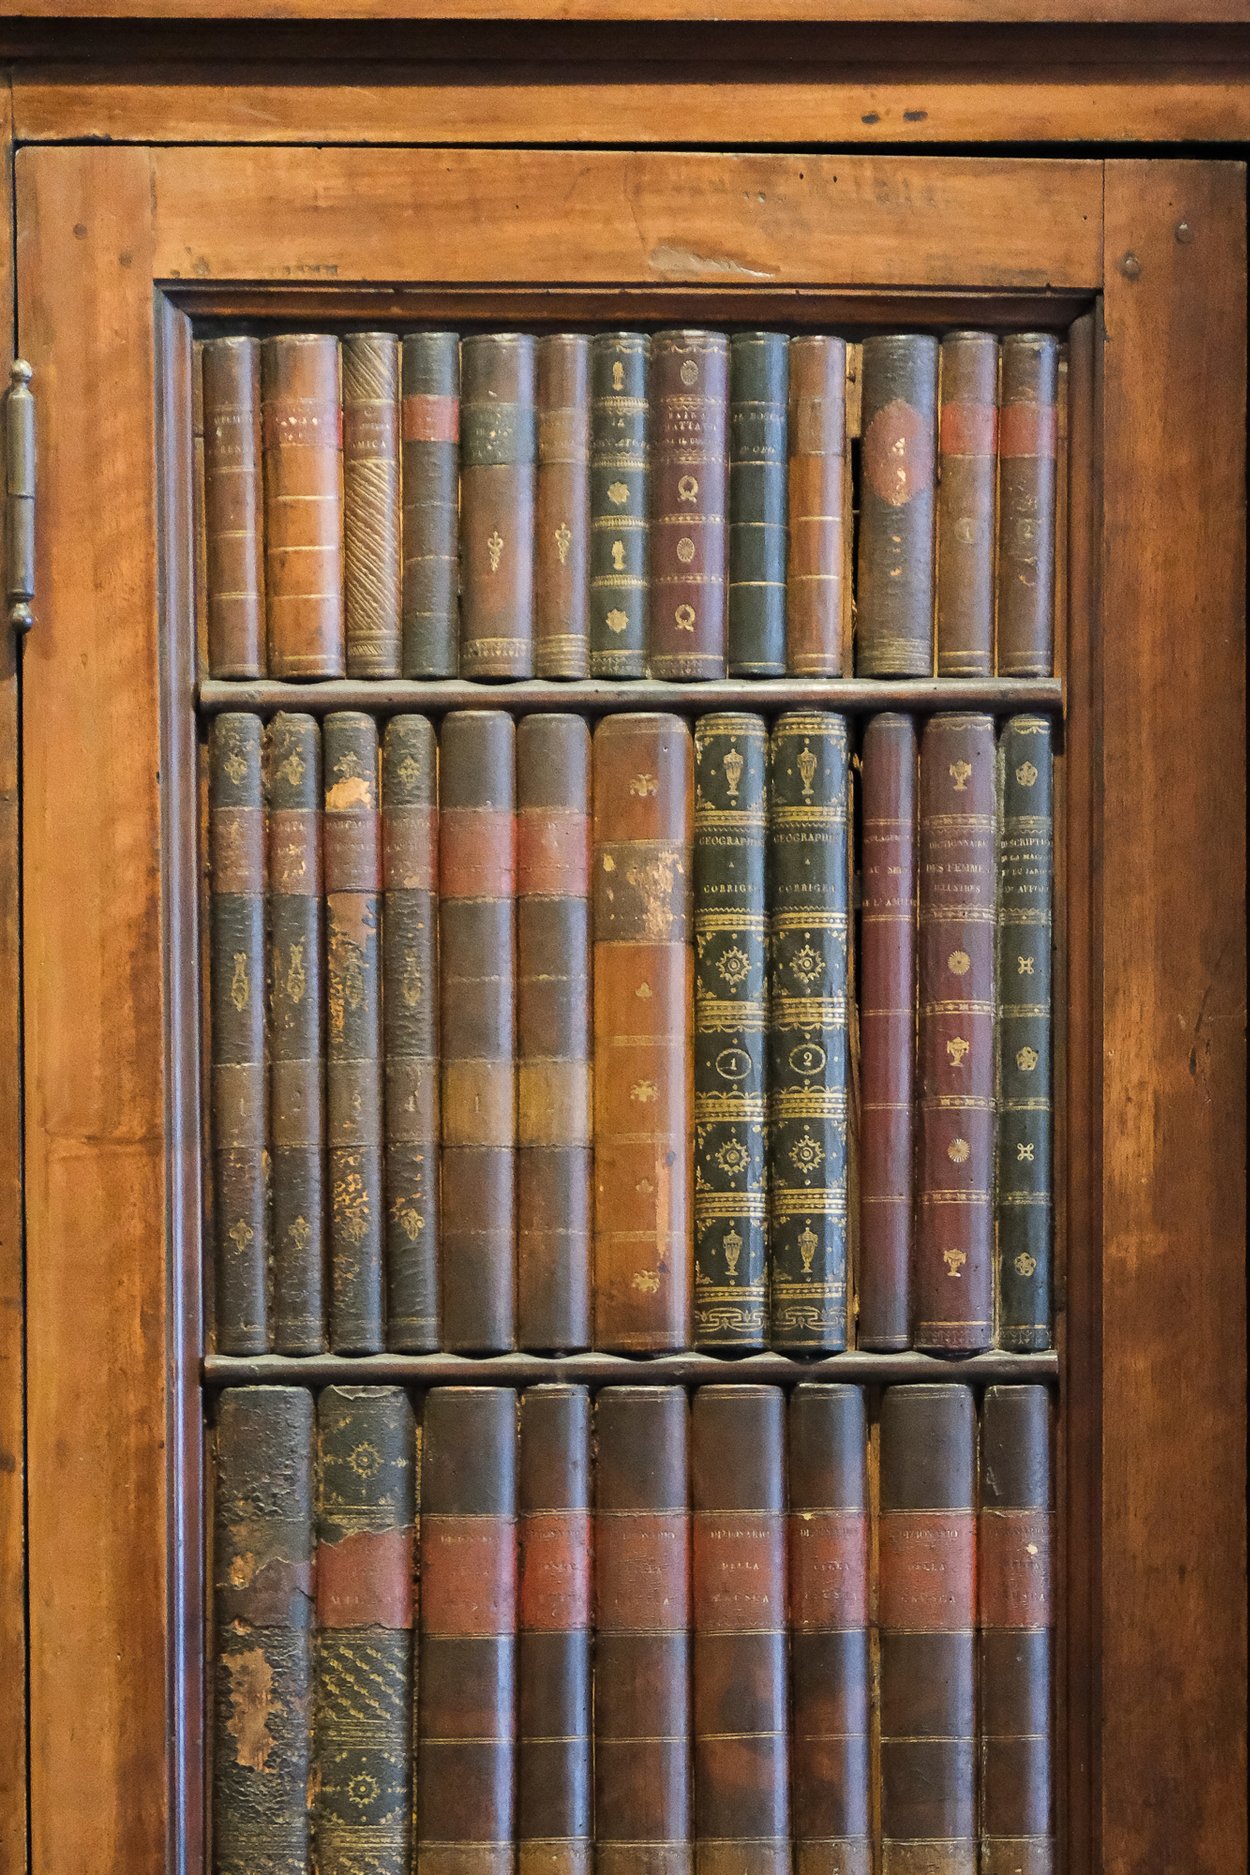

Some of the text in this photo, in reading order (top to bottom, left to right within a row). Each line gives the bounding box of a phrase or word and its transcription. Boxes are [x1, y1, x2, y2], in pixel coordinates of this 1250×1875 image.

[727, 860, 736, 869] A
[804, 857, 812, 866] A
[802, 1050, 814, 1067] 2
